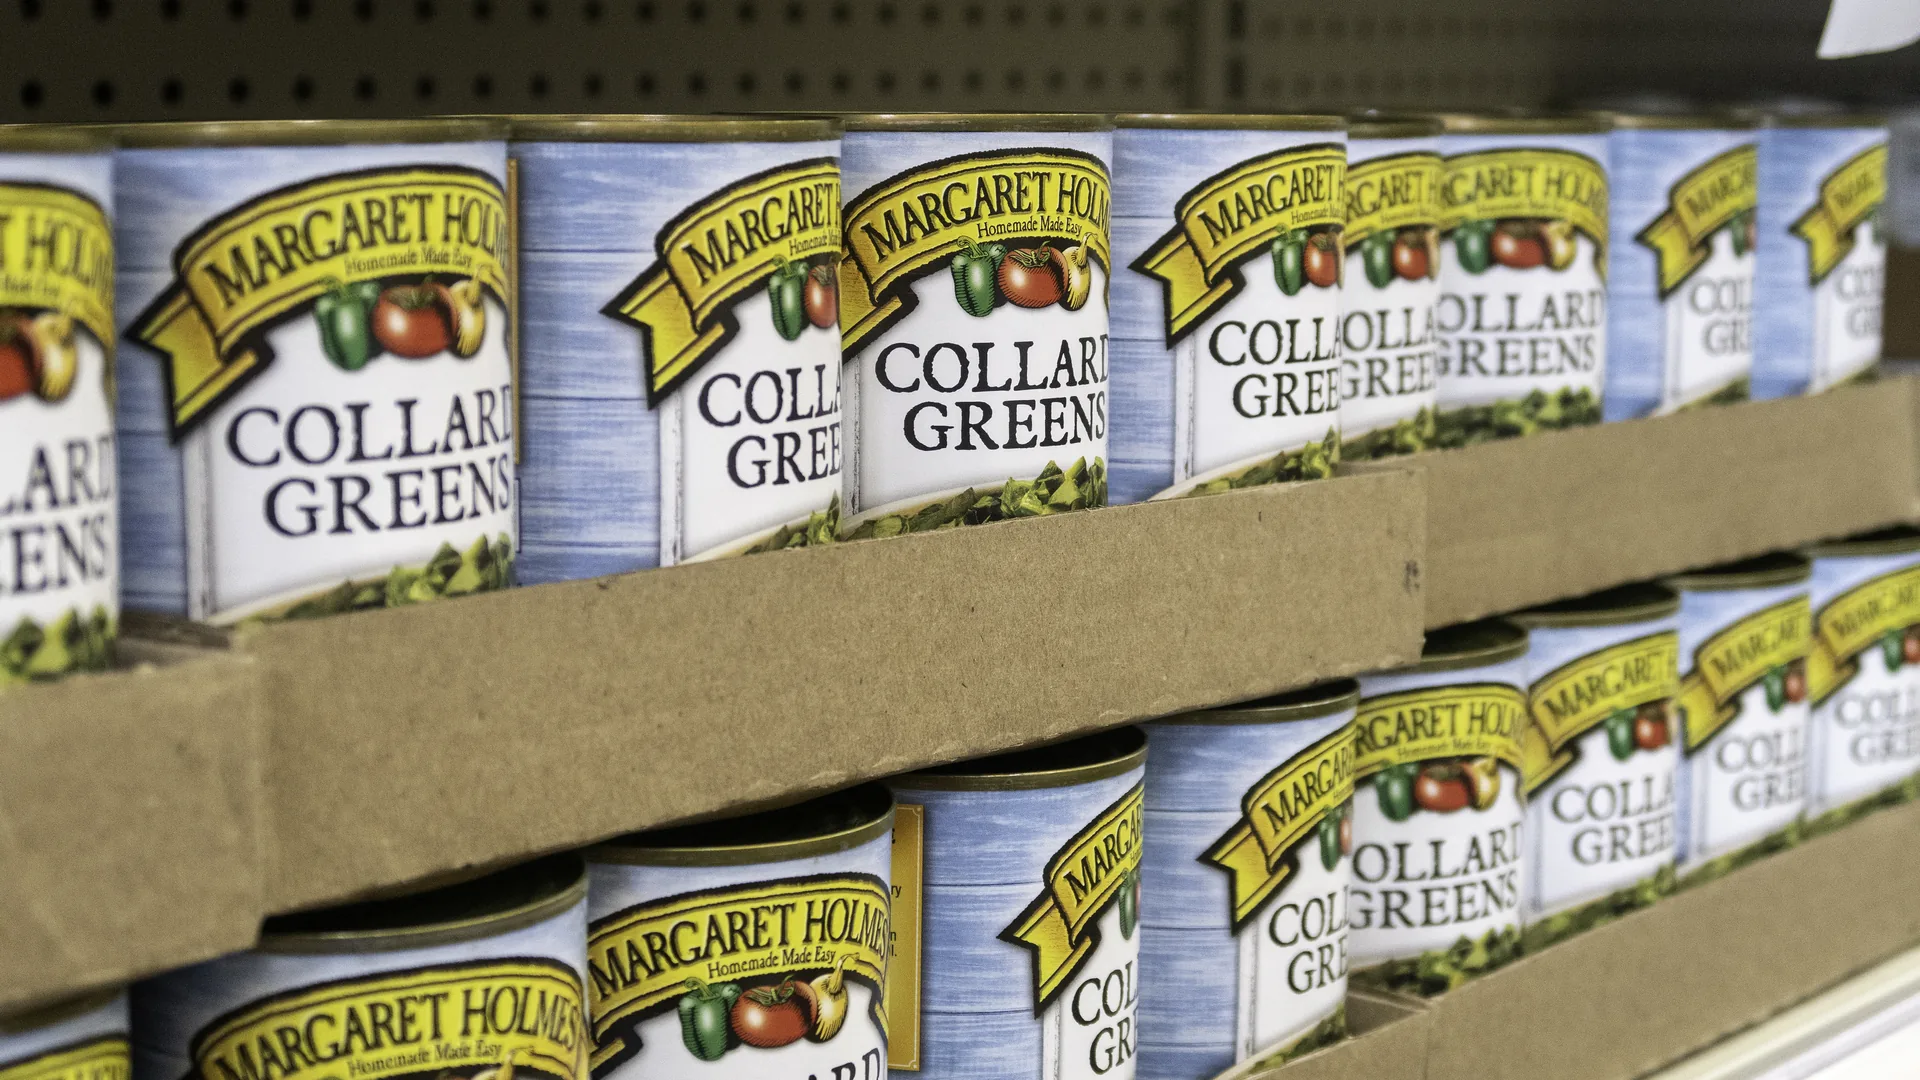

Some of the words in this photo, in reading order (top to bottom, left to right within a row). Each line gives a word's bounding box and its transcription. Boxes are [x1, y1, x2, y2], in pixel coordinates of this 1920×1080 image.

[682, 182, 833, 287] MARGARET
[860, 170, 1053, 263] MARGARET
[977, 215, 1039, 239] Homemade
[1040, 215, 1064, 232] Made
[1065, 216, 1083, 238] Easy
[1197, 164, 1336, 248] MARGARET
[204, 193, 433, 310] MARGARET
[344, 250, 417, 275] Homemade
[421, 246, 449, 265] Made
[875, 333, 1109, 394] COLLARD
[1231, 367, 1342, 420] GREE
[727, 421, 842, 489] GREE
[903, 390, 1106, 452] GREENS
[264, 452, 510, 538] GREENS
[588, 902, 796, 1000] MARGARET
[802, 897, 889, 961] HOLMES
[707, 955, 780, 979] Homemade
[781, 950, 813, 966] Made
[815, 945, 838, 965] Easy
[215, 992, 450, 1080] MARGARET
[460, 985, 580, 1051] HOLMES
[350, 1049, 430, 1077] Homemade
[434, 1044, 471, 1063] Made
[475, 1040, 503, 1063] Easy
